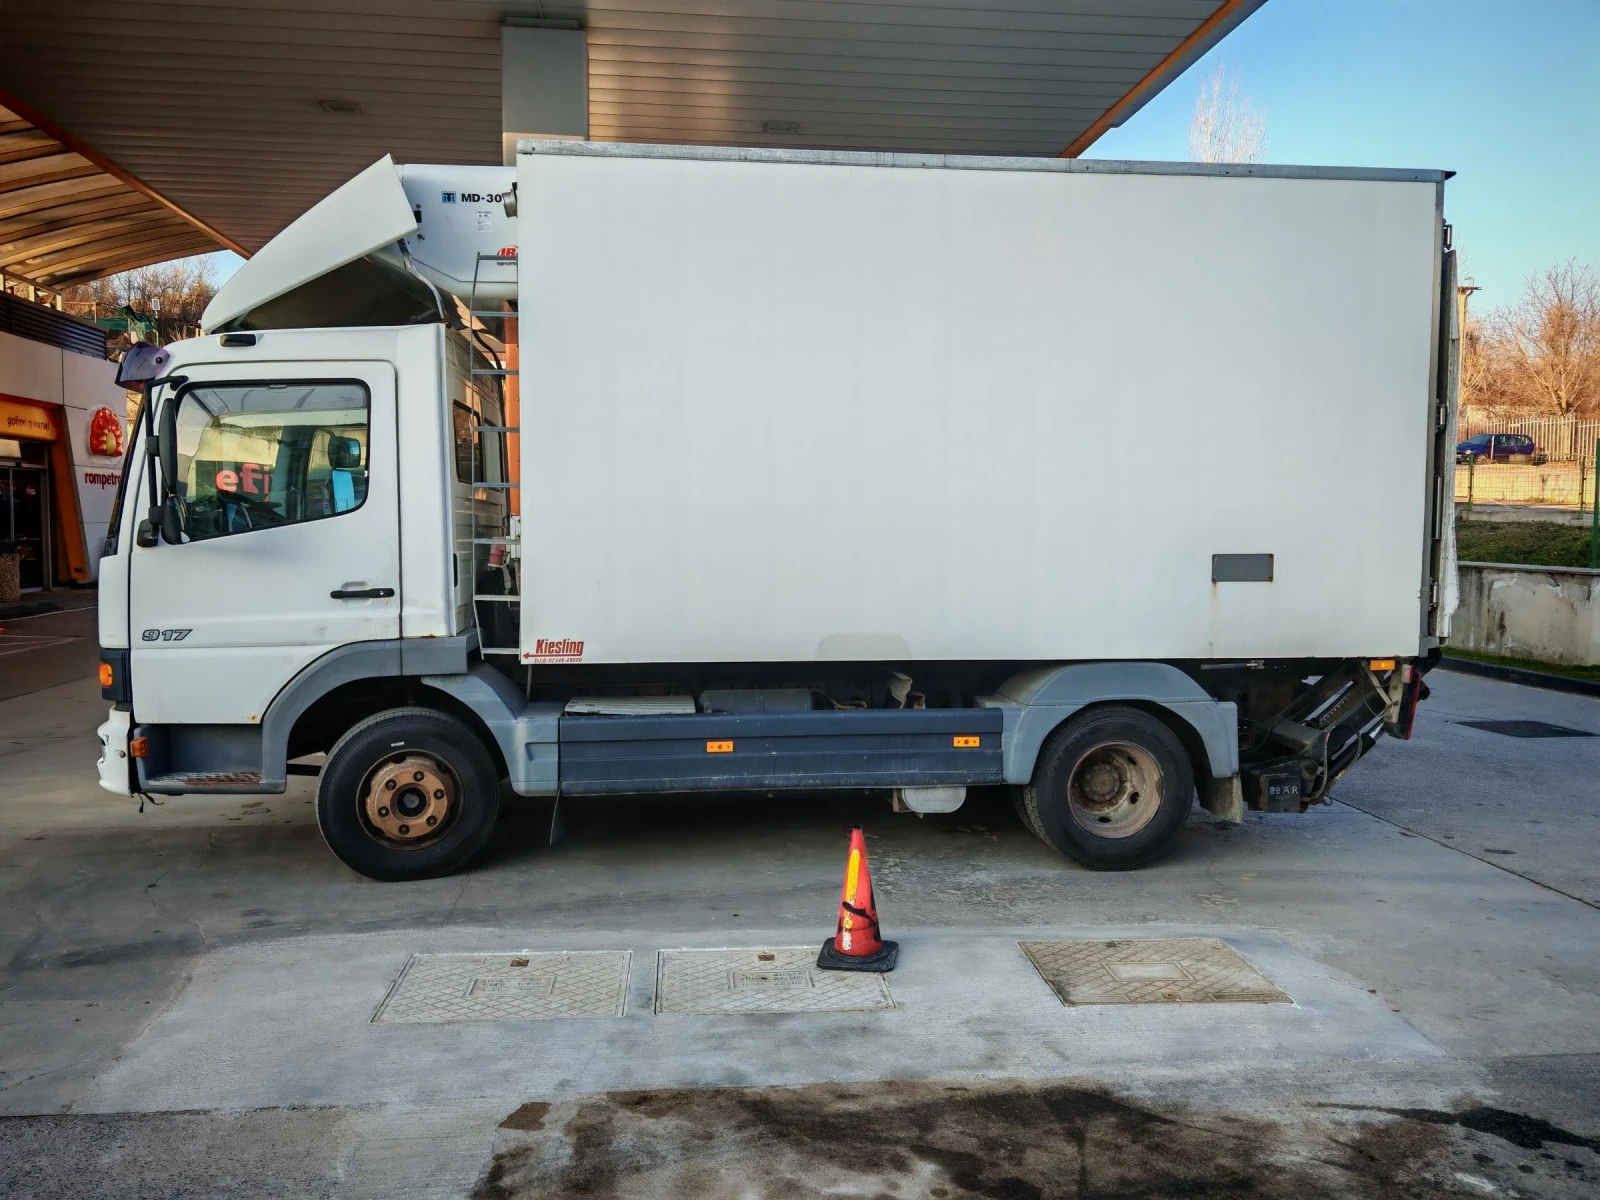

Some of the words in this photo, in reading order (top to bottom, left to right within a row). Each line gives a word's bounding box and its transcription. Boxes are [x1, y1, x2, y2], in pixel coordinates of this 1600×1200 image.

[85, 472, 122, 490] rompetro
[216, 463, 274, 495] efi
[141, 628, 193, 641] 917
[535, 639, 584, 655] Kiesling
